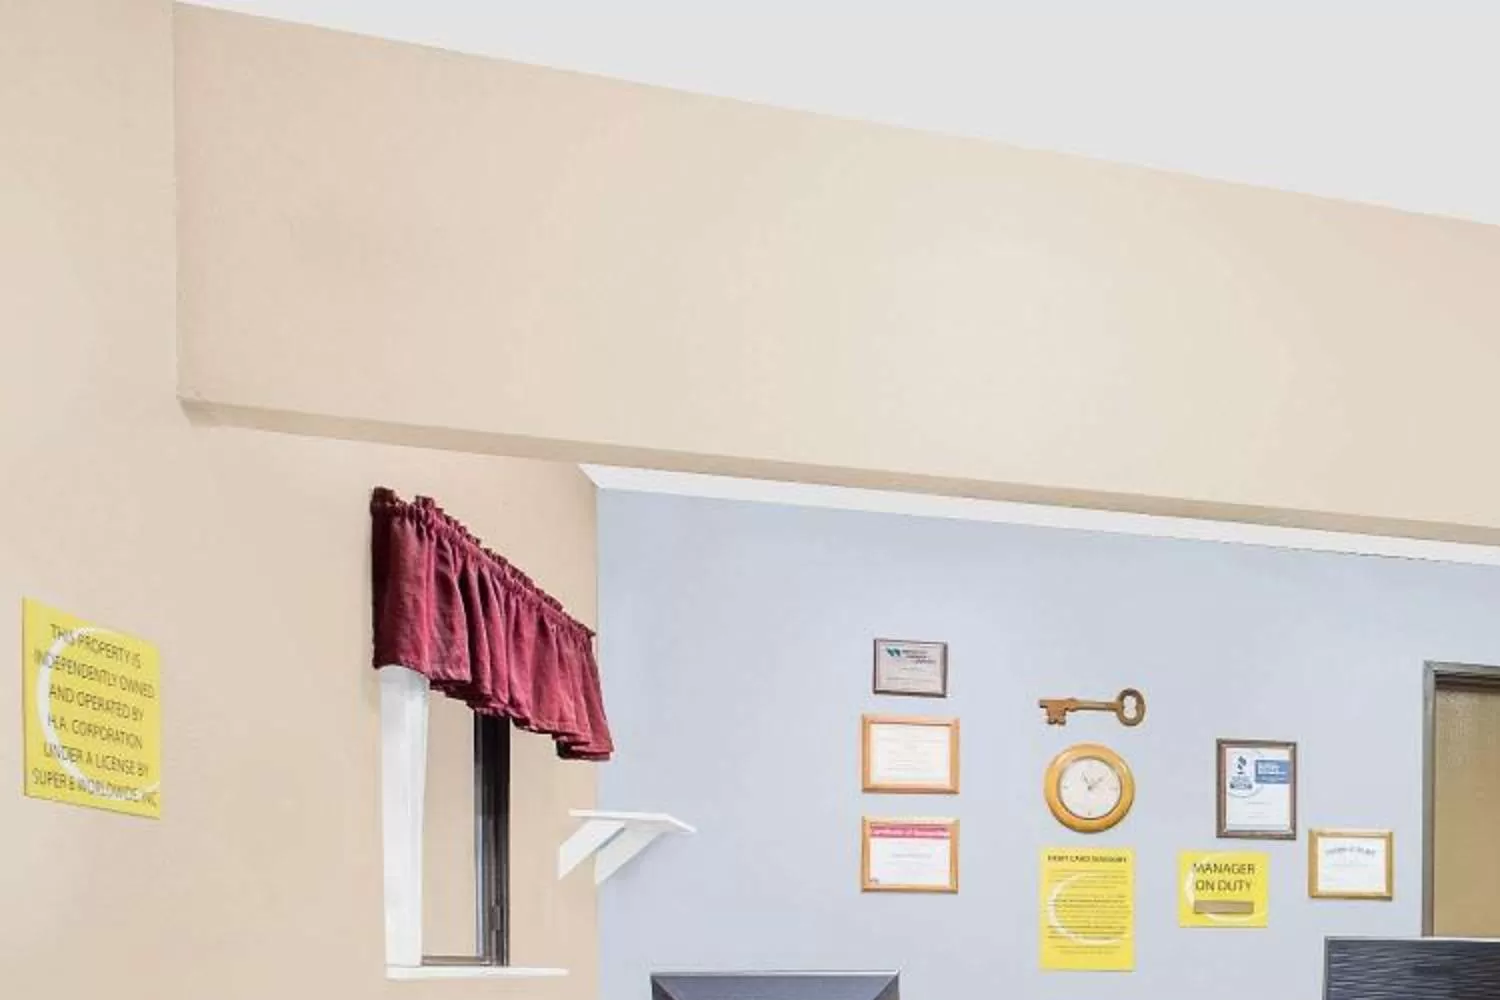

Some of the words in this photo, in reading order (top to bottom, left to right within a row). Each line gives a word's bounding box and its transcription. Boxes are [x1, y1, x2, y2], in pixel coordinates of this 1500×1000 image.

[50, 624, 76, 646] THIS
[77, 635, 131, 664] PROPERTY
[134, 653, 142, 670] IS
[119, 675, 155, 699] OWNED
[49, 685, 75, 704] AND
[76, 691, 131, 719] OPERATED
[132, 709, 145, 722] BY
[72, 719, 143, 750] CORPORATION
[43, 742, 83, 763] UNDER
[85, 751, 93, 765] A
[96, 752, 136, 775] LICENSE
[137, 764, 149, 778] BY
[31, 767, 67, 790] SUPER
[1193, 862, 1256, 875] MANAGER
[1195, 879, 1215, 892] ON
[1218, 879, 1252, 892] DUTY
